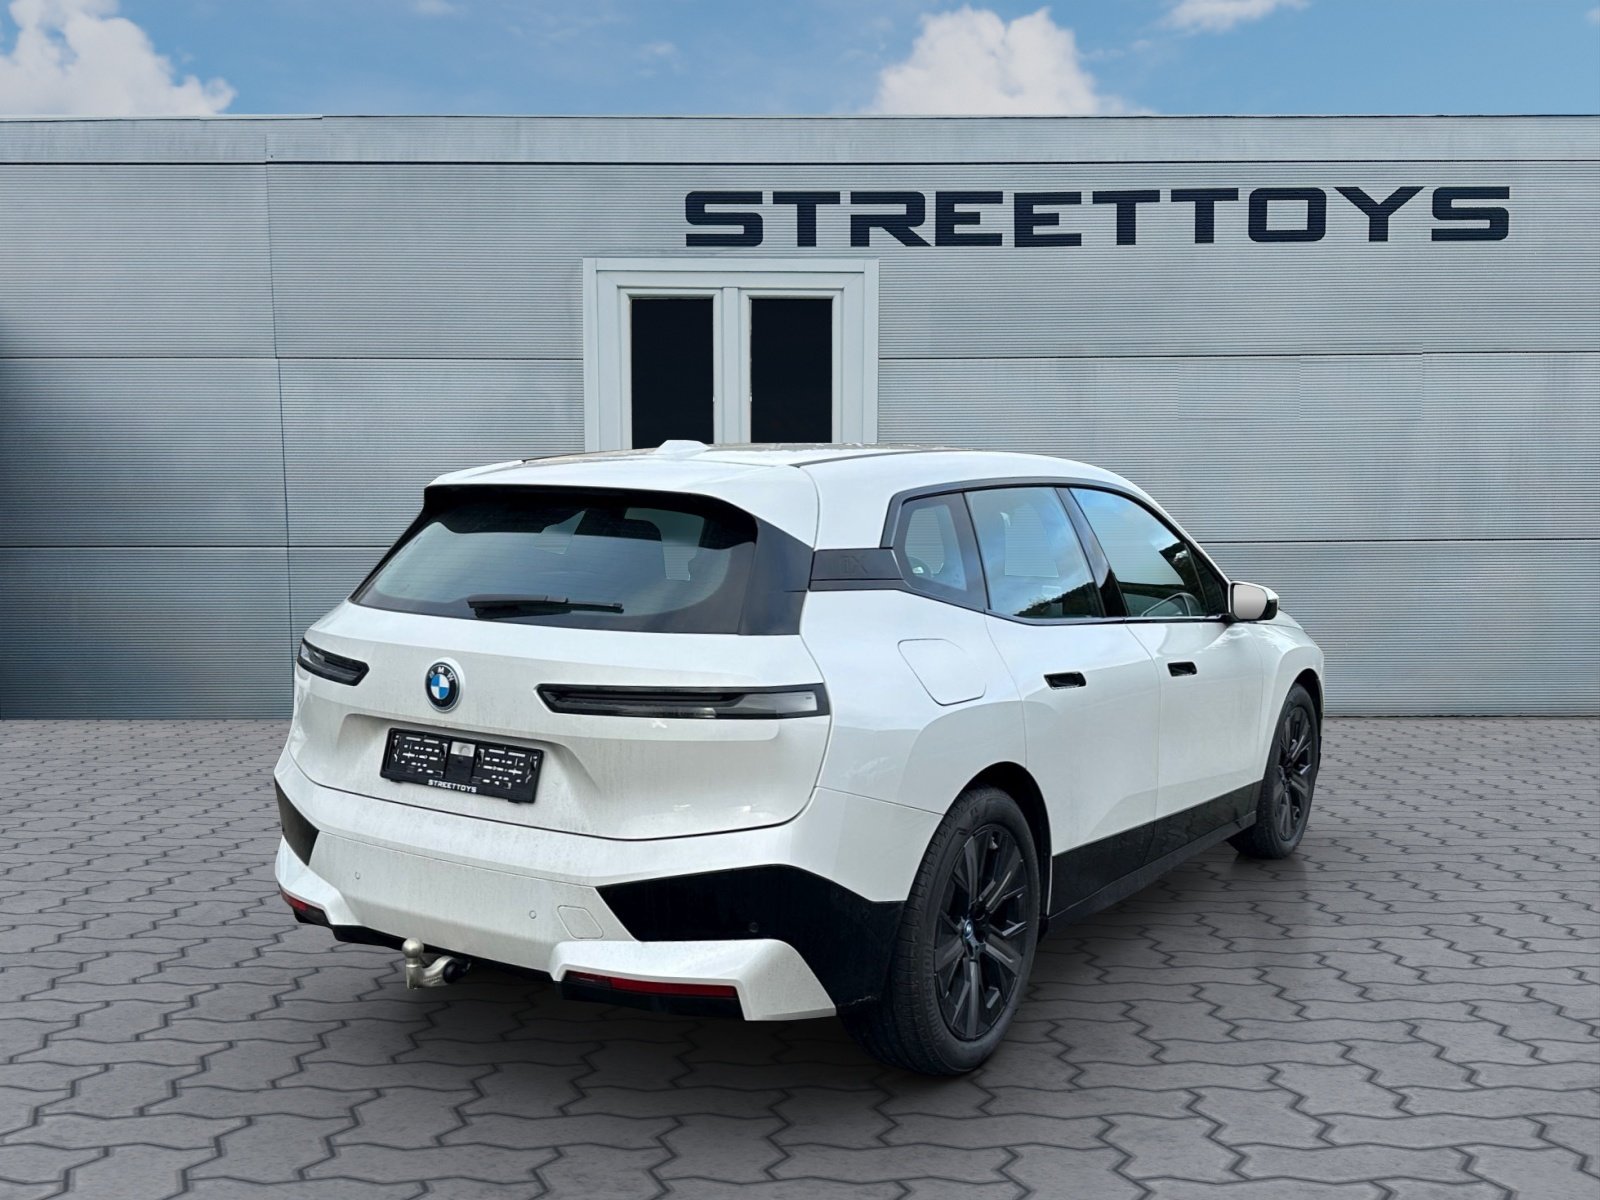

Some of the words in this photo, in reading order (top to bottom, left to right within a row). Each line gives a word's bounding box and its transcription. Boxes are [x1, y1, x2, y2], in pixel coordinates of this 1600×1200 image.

[685, 186, 1510, 247] STREETTOYS
[429, 666, 455, 682] BMW
[428, 779, 477, 793] STREETTOYS
